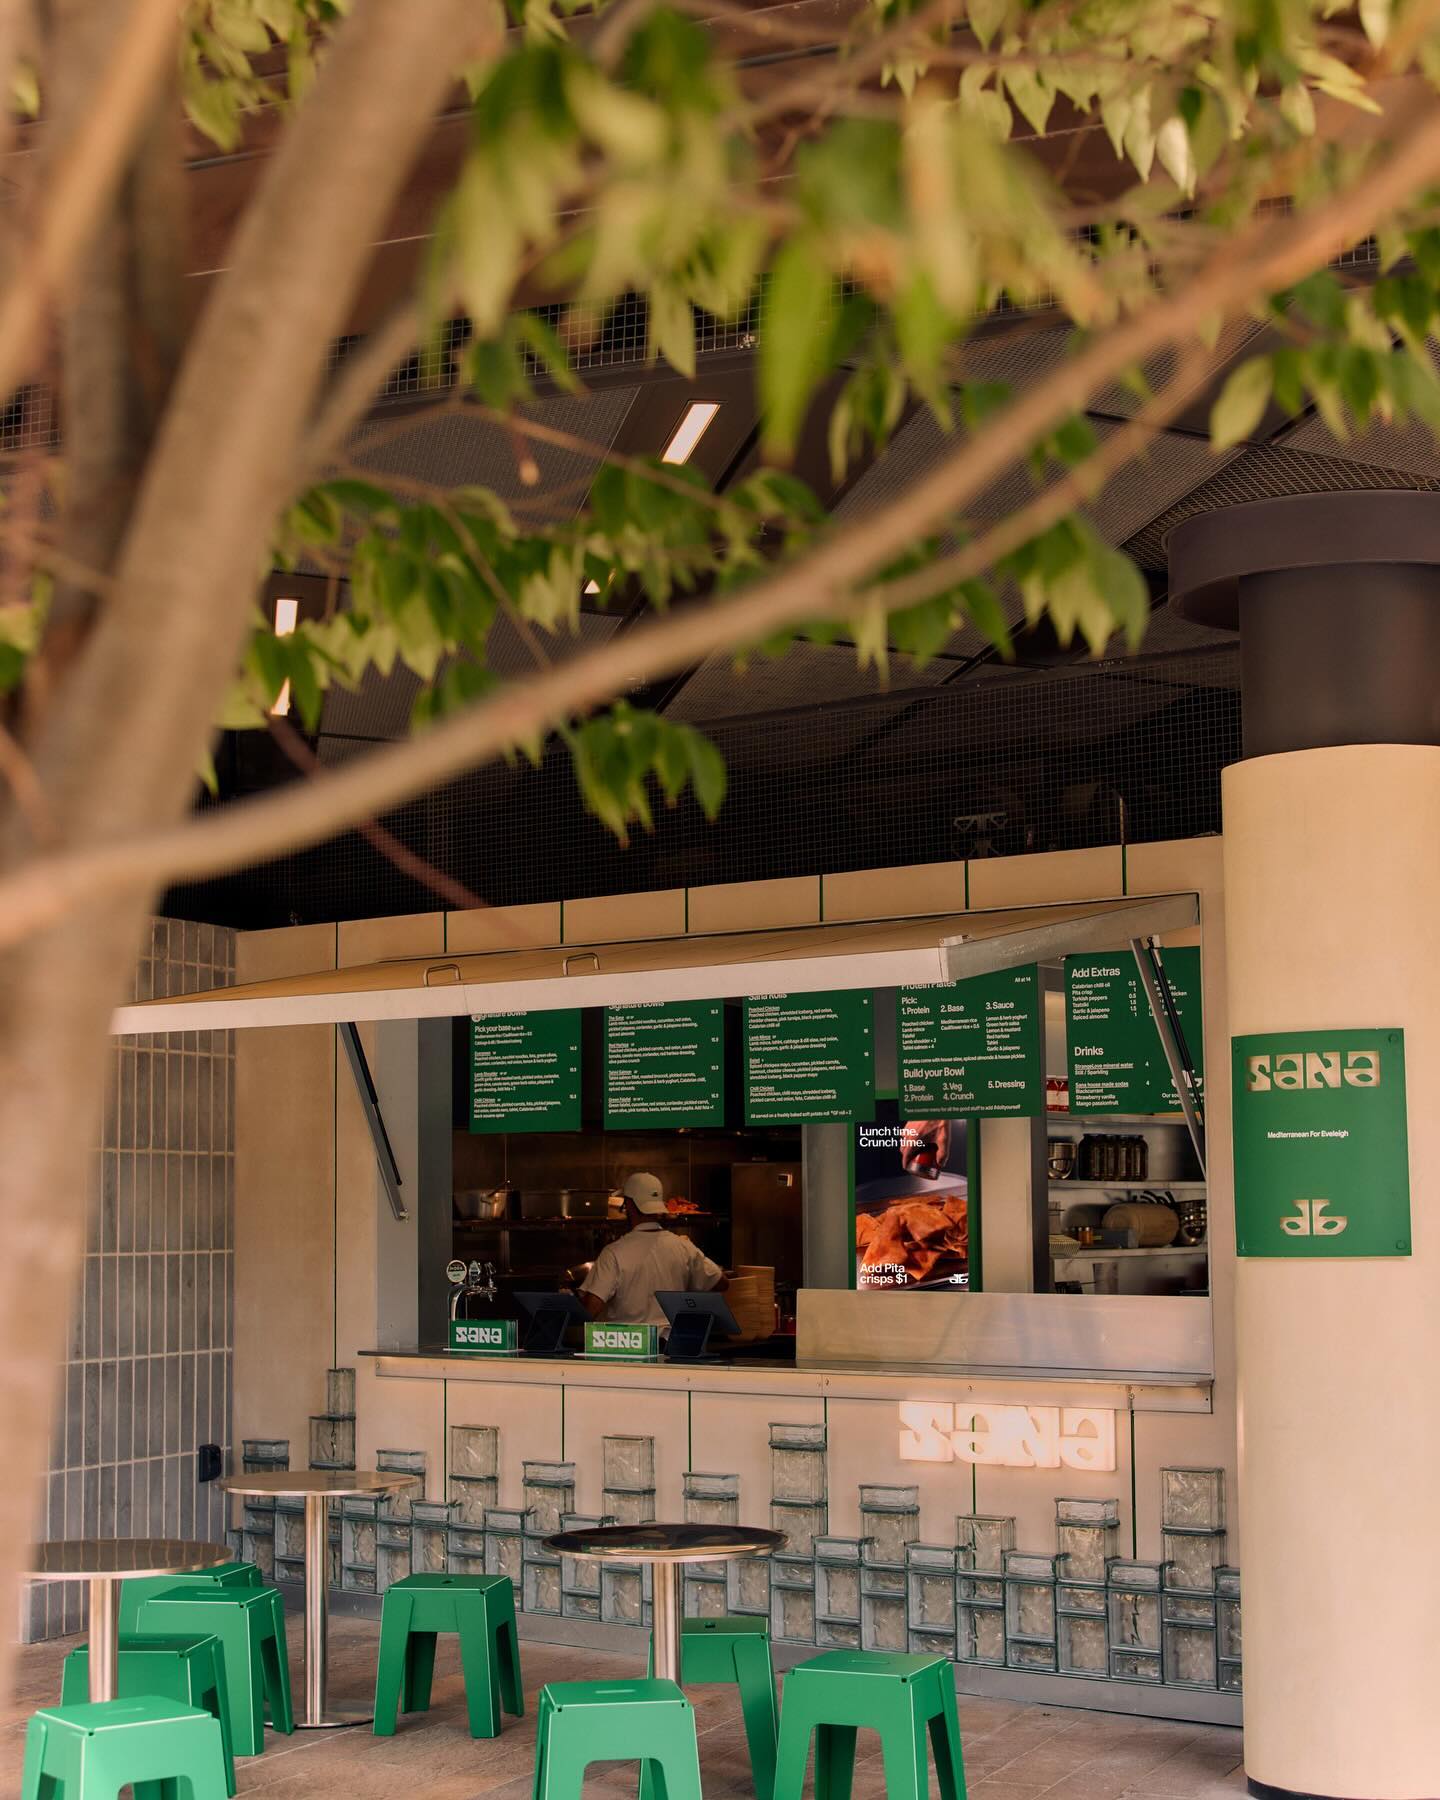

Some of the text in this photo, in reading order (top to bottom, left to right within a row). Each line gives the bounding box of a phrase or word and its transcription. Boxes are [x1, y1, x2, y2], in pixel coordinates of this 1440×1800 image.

[1071, 966, 1120, 978] Add Extras
[908, 1006, 929, 1014] Protein
[948, 1004, 964, 1012] Base
[986, 1001, 1014, 1010] 3. Sauce
[1074, 1046, 1103, 1056] Drinks
[903, 1066, 964, 1079] Build your Bowl
[950, 1083, 962, 1092] Veg
[995, 1080, 1025, 1090] Dressing
[950, 1092, 974, 1100] Crunch
[860, 1126, 919, 1136] Lunch time.
[1321, 1130, 1349, 1138] Eveleigh
[860, 1137, 925, 1147] Crunch time.
[860, 1263, 905, 1273] Add Pita
[860, 1273, 908, 1285] crisps $1
